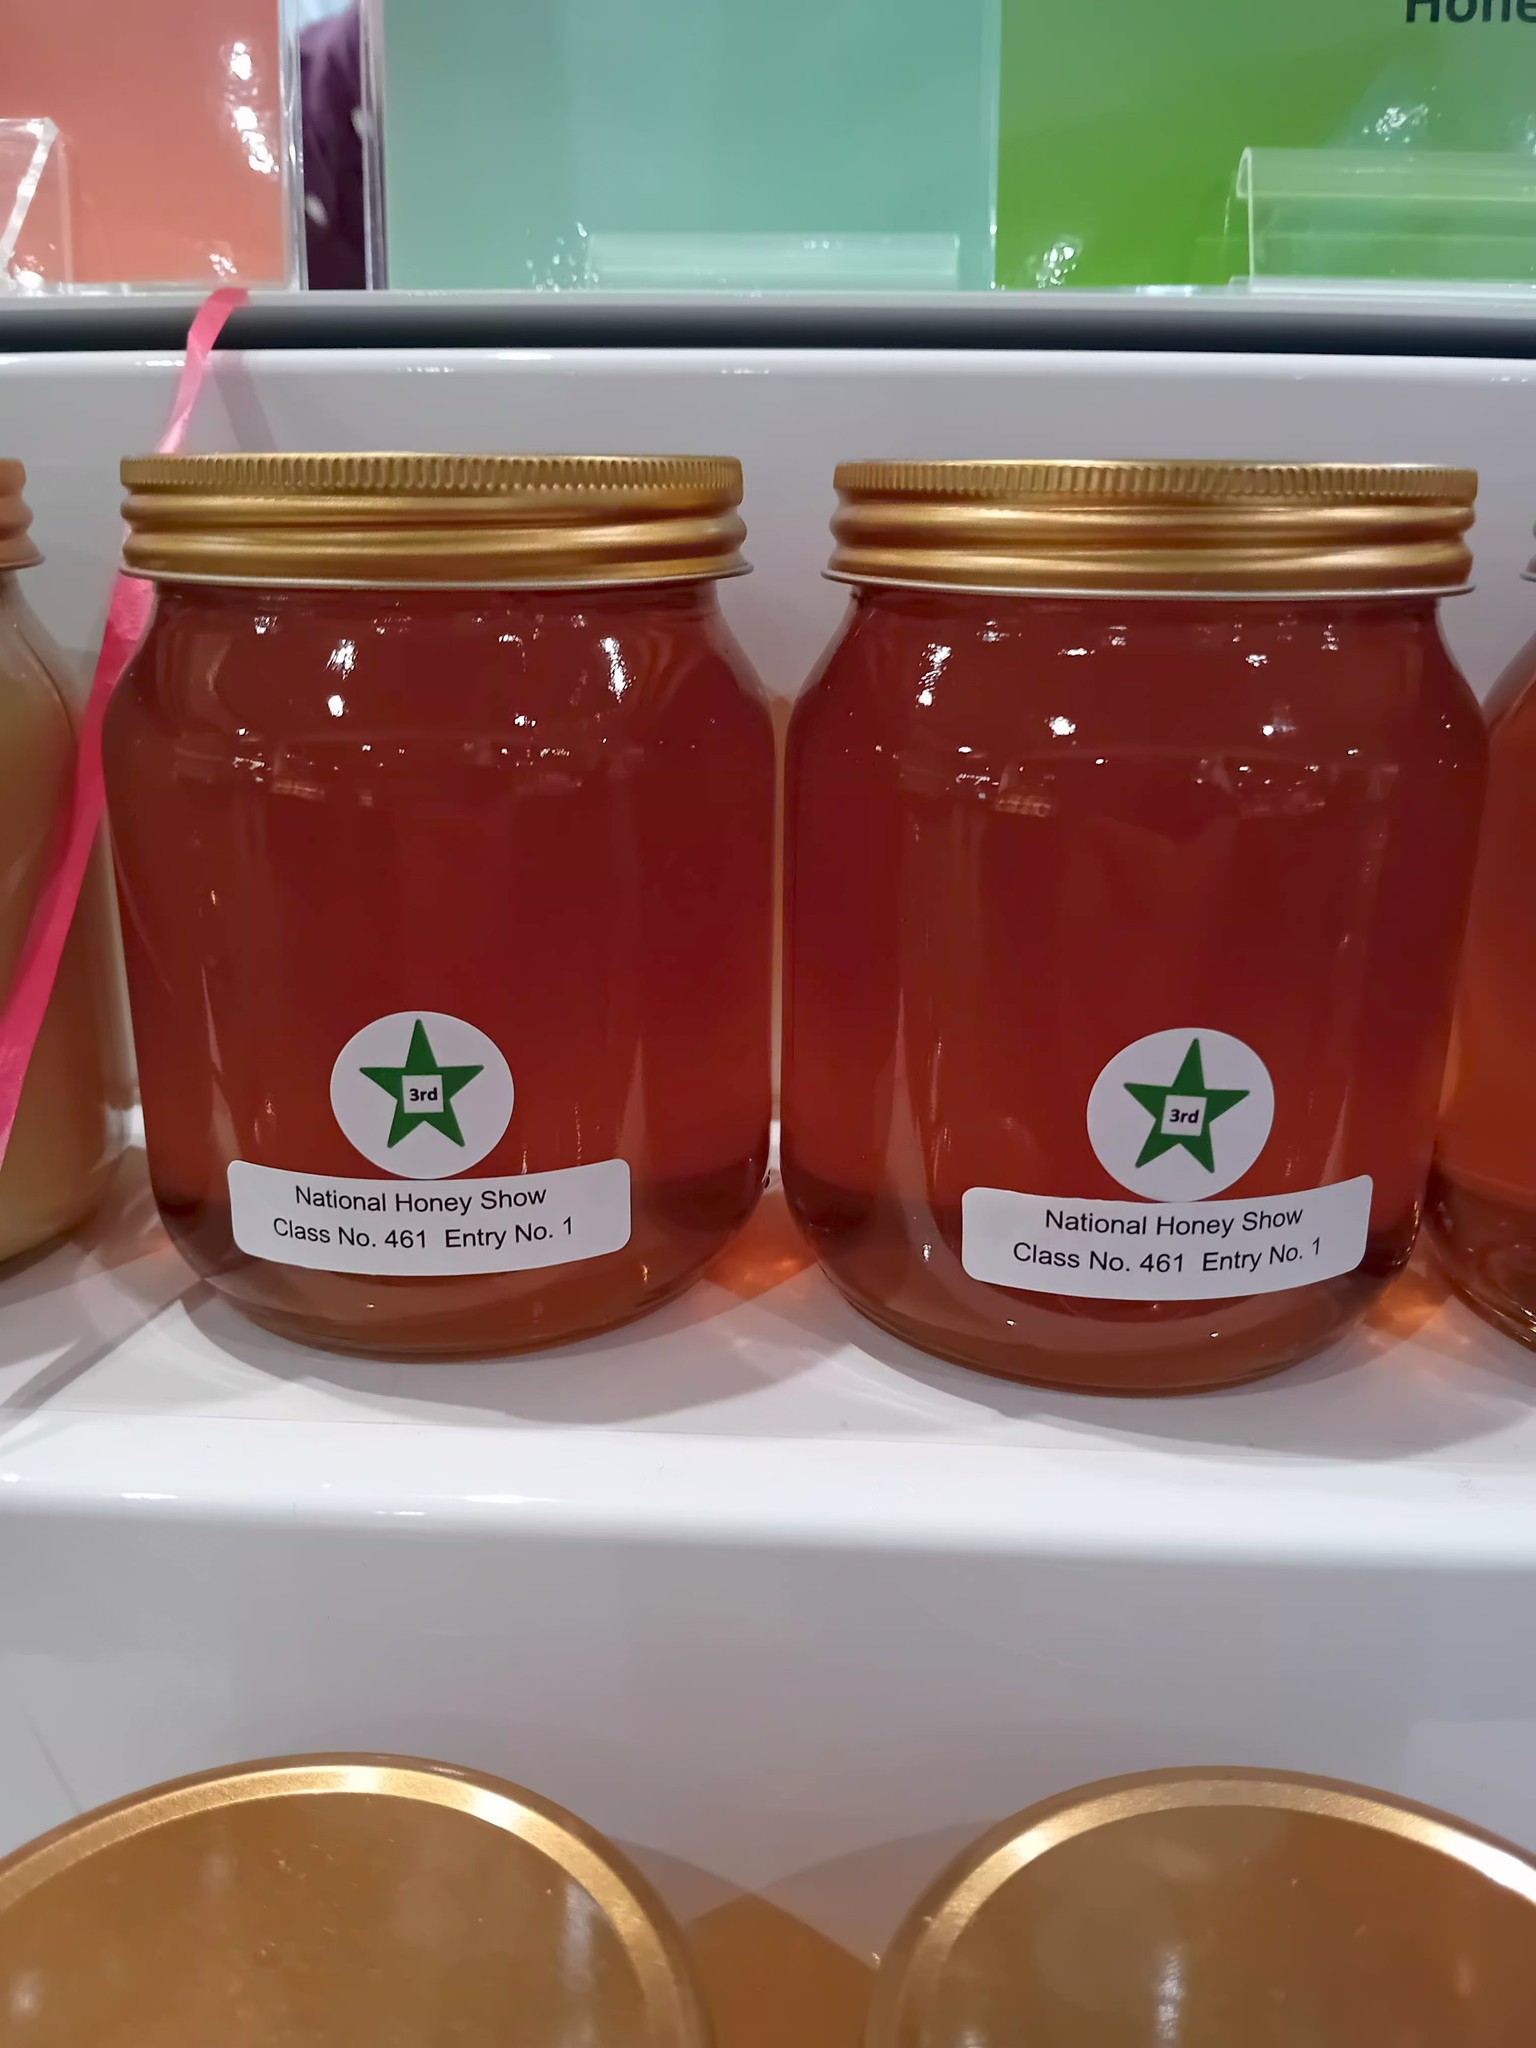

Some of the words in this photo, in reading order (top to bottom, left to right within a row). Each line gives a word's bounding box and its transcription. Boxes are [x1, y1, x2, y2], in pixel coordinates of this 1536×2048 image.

[409, 1086, 438, 1102] 3rd
[1169, 1108, 1200, 1124] 3rd
[295, 1185, 387, 1212] National
[395, 1192, 473, 1217] Honey
[480, 1188, 547, 1210] Show
[273, 1217, 331, 1244] Class
[338, 1226, 377, 1248] No.
[384, 1229, 426, 1249] 461
[445, 1228, 507, 1251] Entry
[515, 1222, 554, 1244] No.
[563, 1216, 572, 1235] 1
[1045, 1209, 1147, 1235] National
[1156, 1215, 1235, 1239] Honey
[1241, 1208, 1304, 1232] Show
[1013, 1241, 1081, 1269] Class
[1089, 1250, 1130, 1272] No.
[1139, 1253, 1183, 1273] 461
[1202, 1250, 1263, 1273] Entry
[1269, 1243, 1303, 1265] No.
[1312, 1236, 1320, 1256] 1
